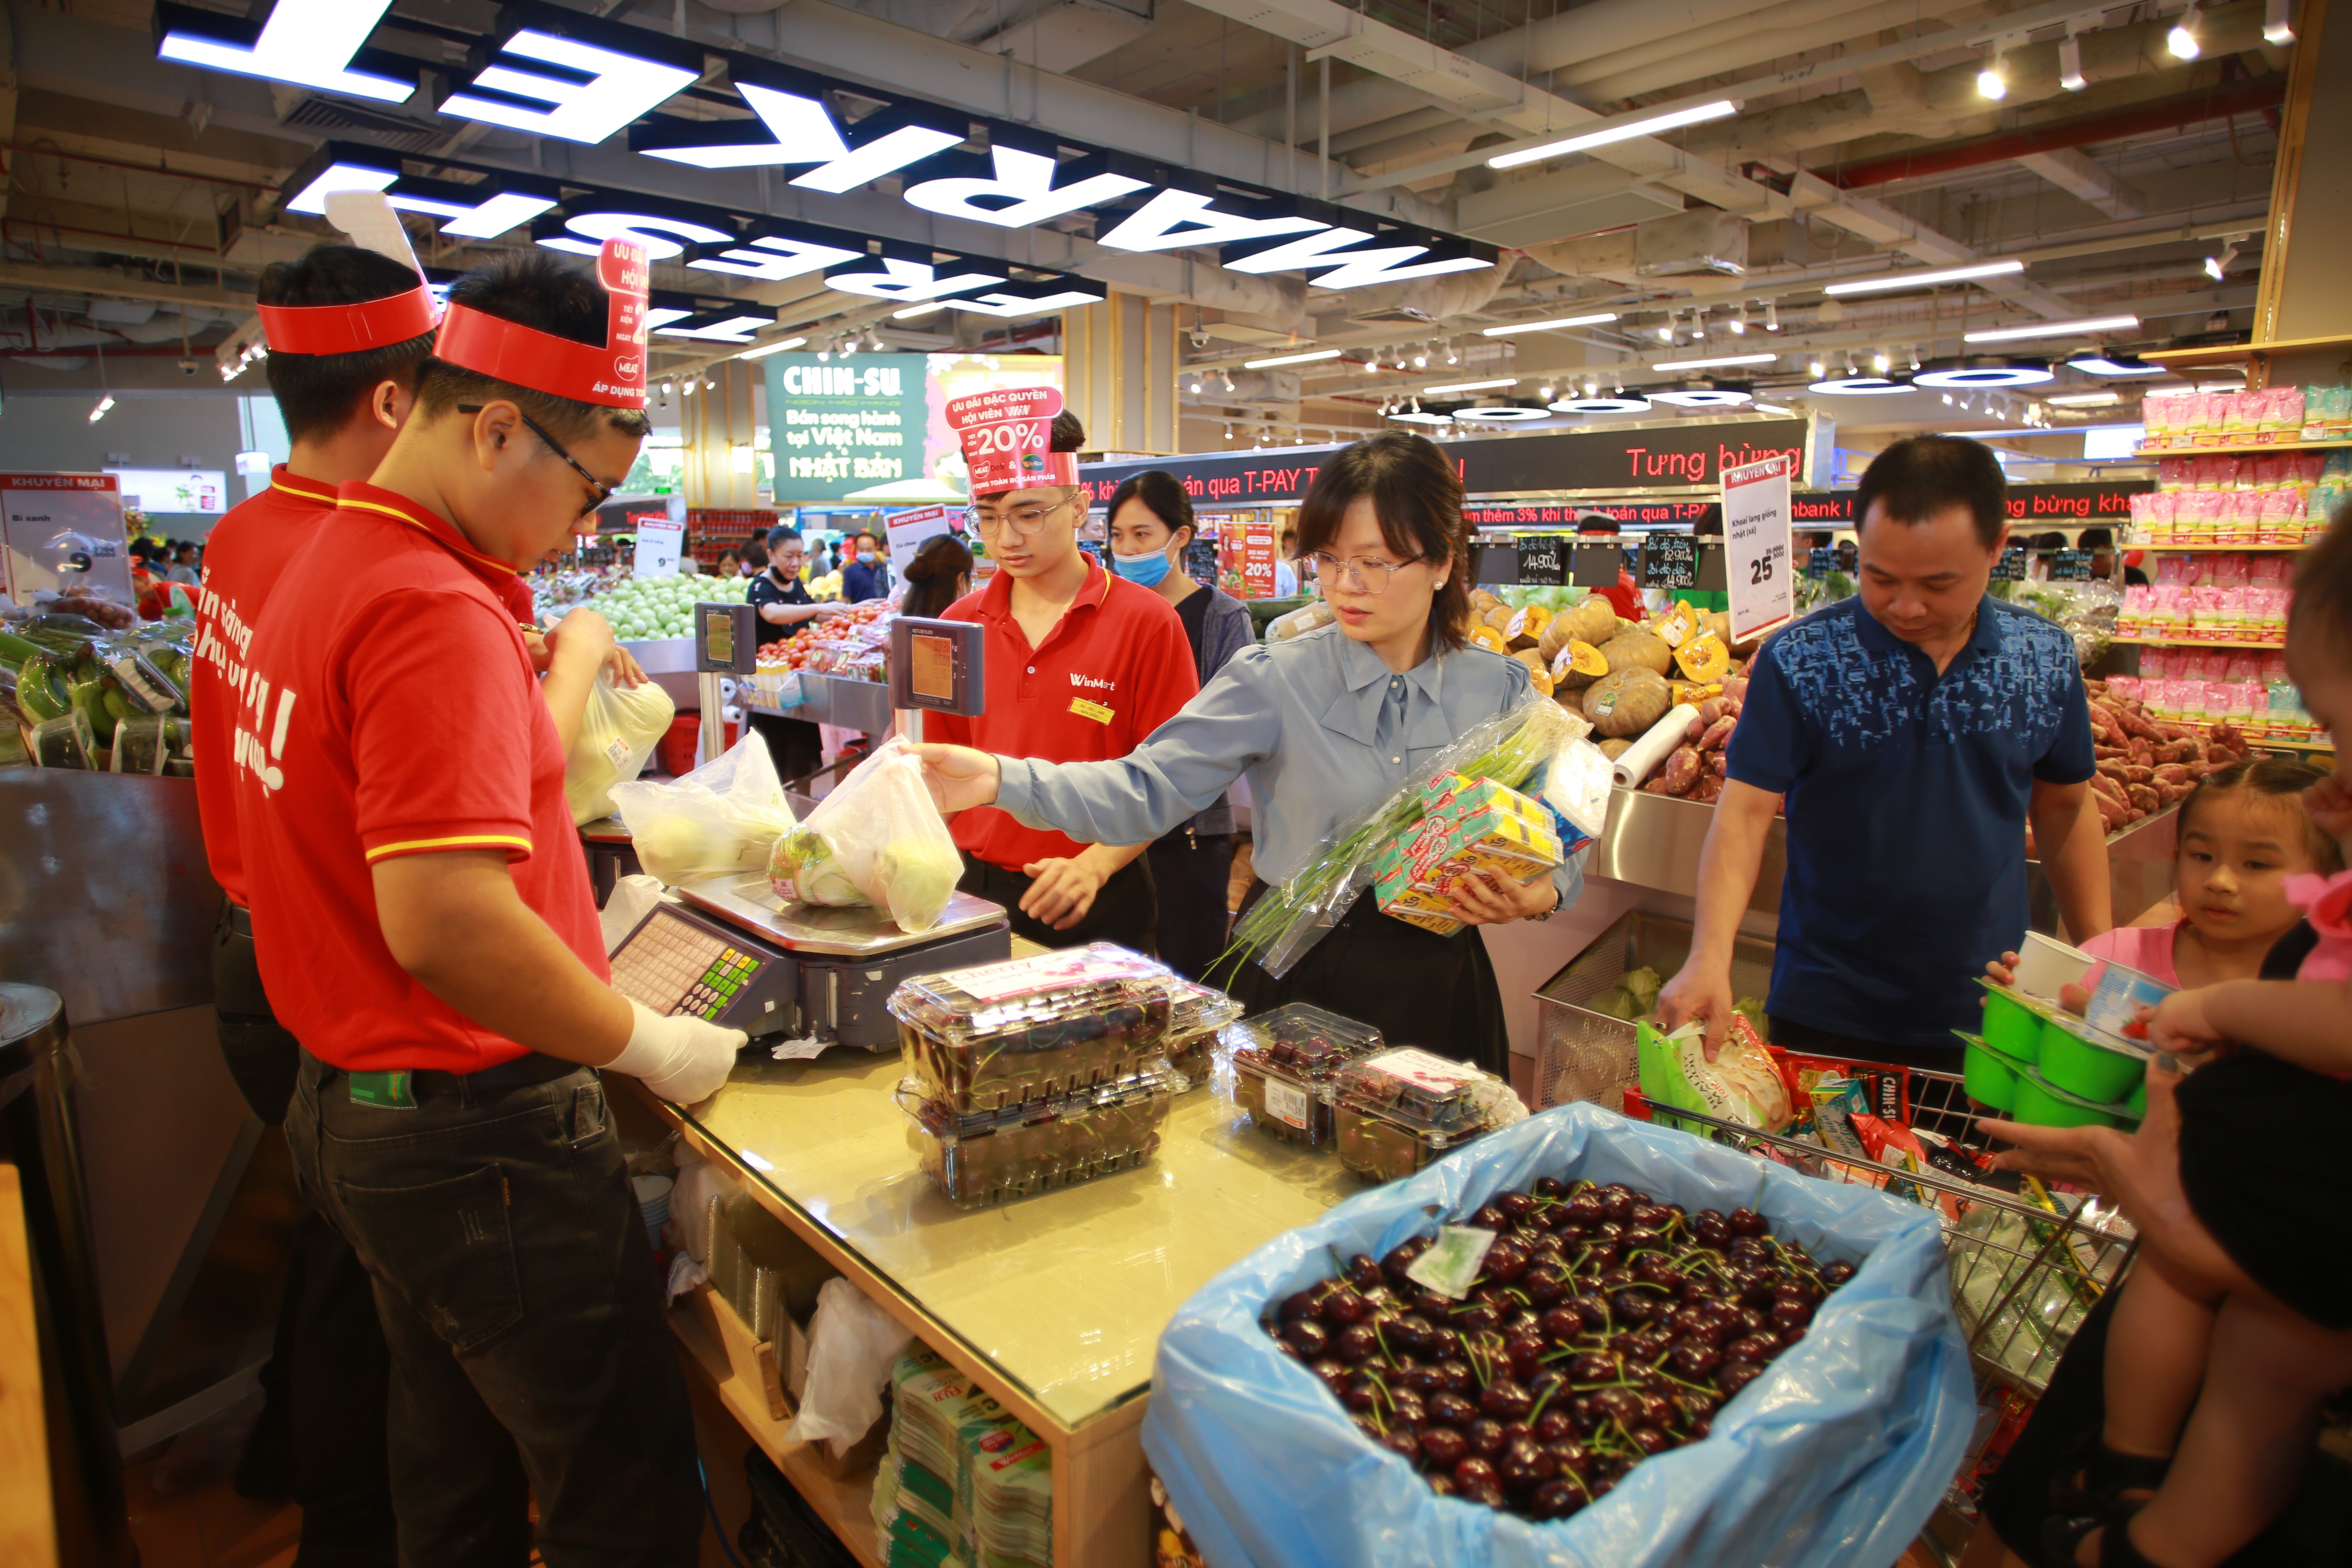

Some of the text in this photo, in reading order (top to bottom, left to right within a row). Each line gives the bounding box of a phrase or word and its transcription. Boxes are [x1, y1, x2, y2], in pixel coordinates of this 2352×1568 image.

[616, 332, 632, 342] NGAY
[619, 361, 638, 374] MEAT
[592, 381, 609, 393] ÁP
[610, 386, 635, 399] DỤNG
[783, 365, 901, 396] CHIN-SU
[952, 388, 1048, 412] ƯU ĐÃI ĐẶC QUYỀN
[820, 412, 860, 429] song
[860, 410, 902, 426] hành
[961, 412, 977, 425] HỘI
[978, 408, 1003, 421] VIÊN
[786, 426, 903, 450] tại Việt Nam
[976, 422, 1045, 456] 20%
[974, 460, 1042, 475] MEAT Deli & WinEco
[1626, 448, 1707, 482] Tưng
[11, 476, 106, 490] KHUYẾN MẠI
[976, 481, 989, 490] DỤNG
[990, 477, 1009, 486] TOÀN
[1009, 475, 1020, 484] BỘ
[1021, 473, 1036, 483] SẢN
[1037, 472, 1056, 481] PHẨM
[1208, 477, 1241, 500] qua
[1244, 468, 1301, 494] T-PAY
[1483, 507, 1516, 523] thêm
[1517, 507, 1538, 522] 3%
[1542, 506, 1561, 522] khi
[1606, 505, 1637, 521] toán
[1641, 507, 1669, 524] qua
[2033, 494, 2091, 517] bừng
[892, 512, 924, 525] KHUYẾN
[1732, 508, 1777, 528] Khoai lang giống
[1732, 528, 1746, 539] nhật
[69, 552, 92, 573] 9
[658, 557, 666, 568] 9
[1245, 562, 1273, 577] 20%
[1751, 555, 1773, 586] 25
[1070, 673, 1115, 691] WinMart
[950, 961, 1032, 981] Cherry
[1404, 1051, 1450, 1071] Cherry
[1682, 1056, 1718, 1110] HEALTHY
[1882, 1077, 1896, 1121] CHIN-SU
[931, 1385, 963, 1403] FUJI
